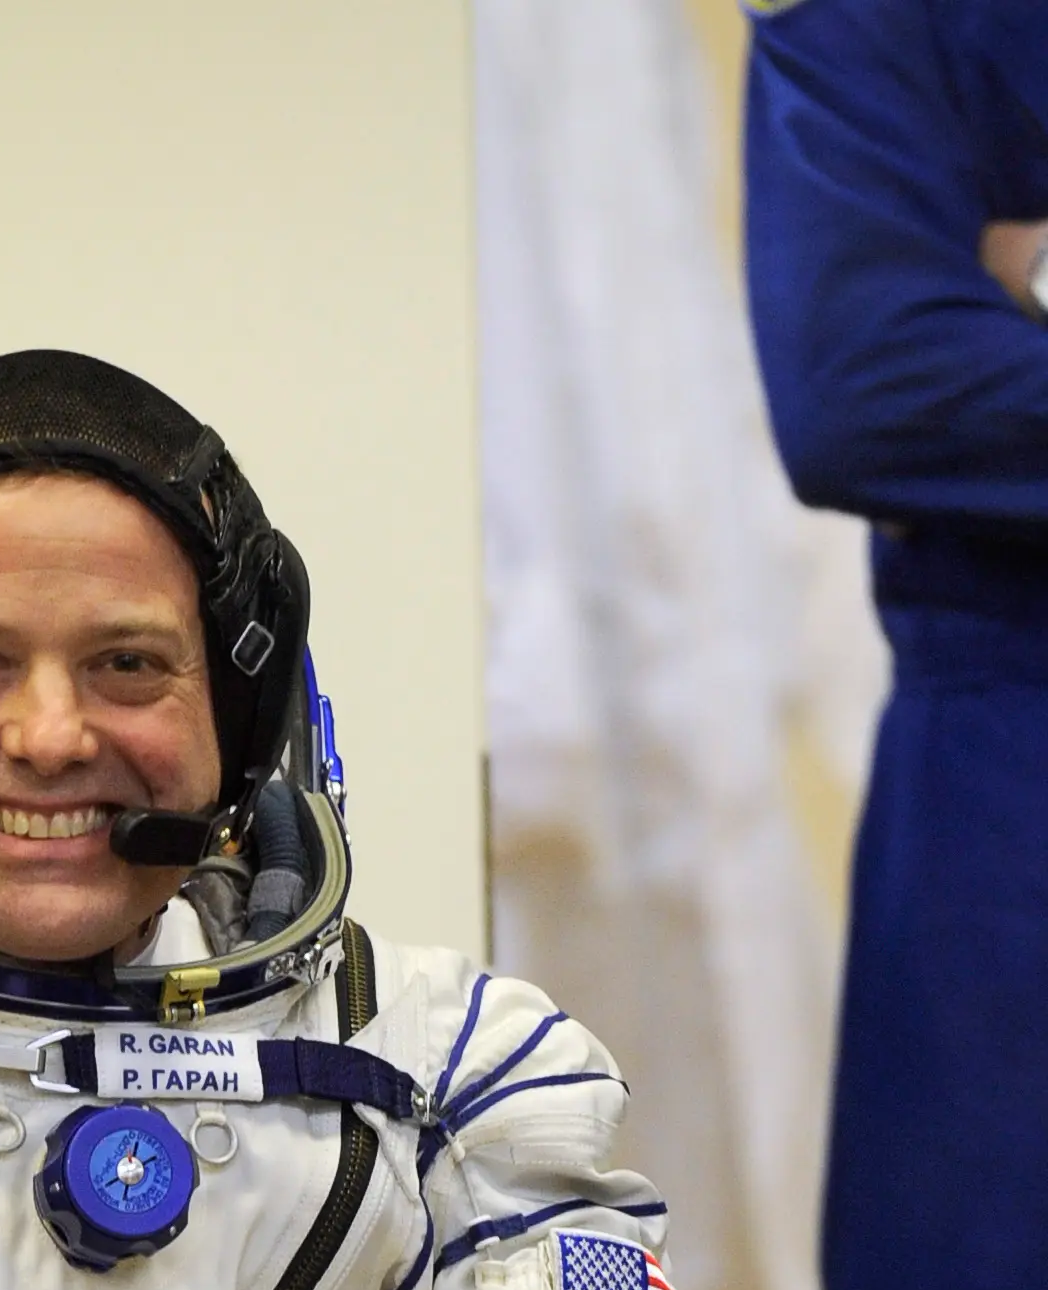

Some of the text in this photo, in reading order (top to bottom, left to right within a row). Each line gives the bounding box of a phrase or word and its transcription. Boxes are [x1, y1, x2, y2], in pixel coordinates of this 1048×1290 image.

[119, 1033, 235, 1057] R. GARAN
[152, 1069, 239, 1093] ГАРАН
